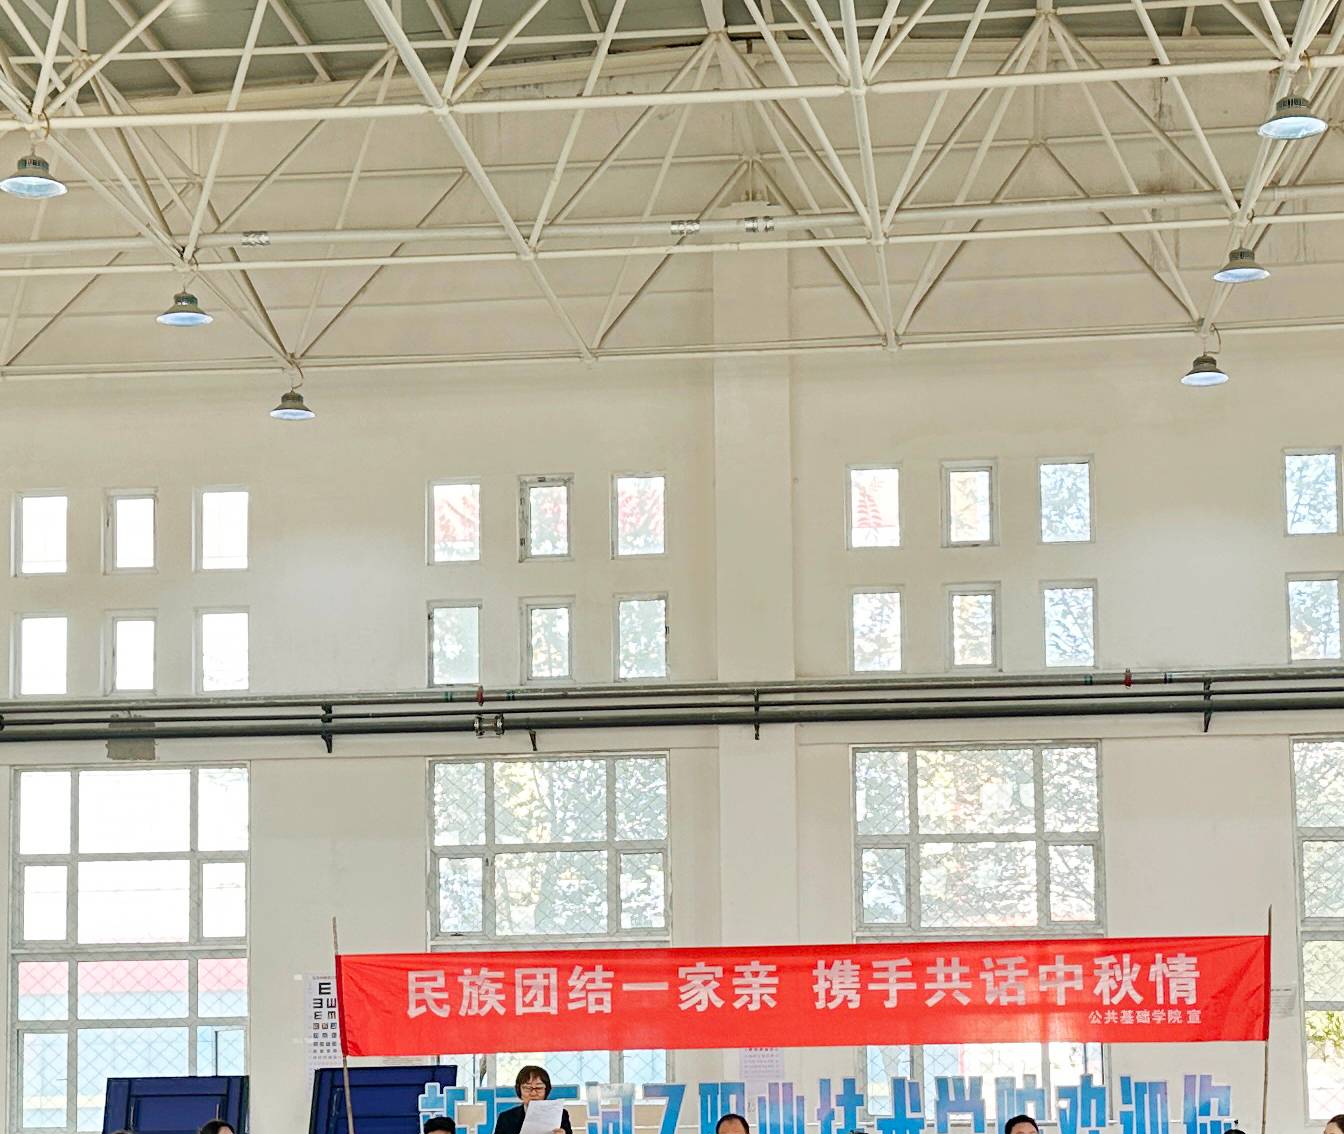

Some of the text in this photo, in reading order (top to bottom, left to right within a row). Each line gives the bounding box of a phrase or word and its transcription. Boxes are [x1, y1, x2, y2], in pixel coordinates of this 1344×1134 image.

[406, 952, 1201, 1019] 民族团结一家亲 携手共话中秋情
[1089, 1009, 1202, 1025] 公共基础学院 宣
